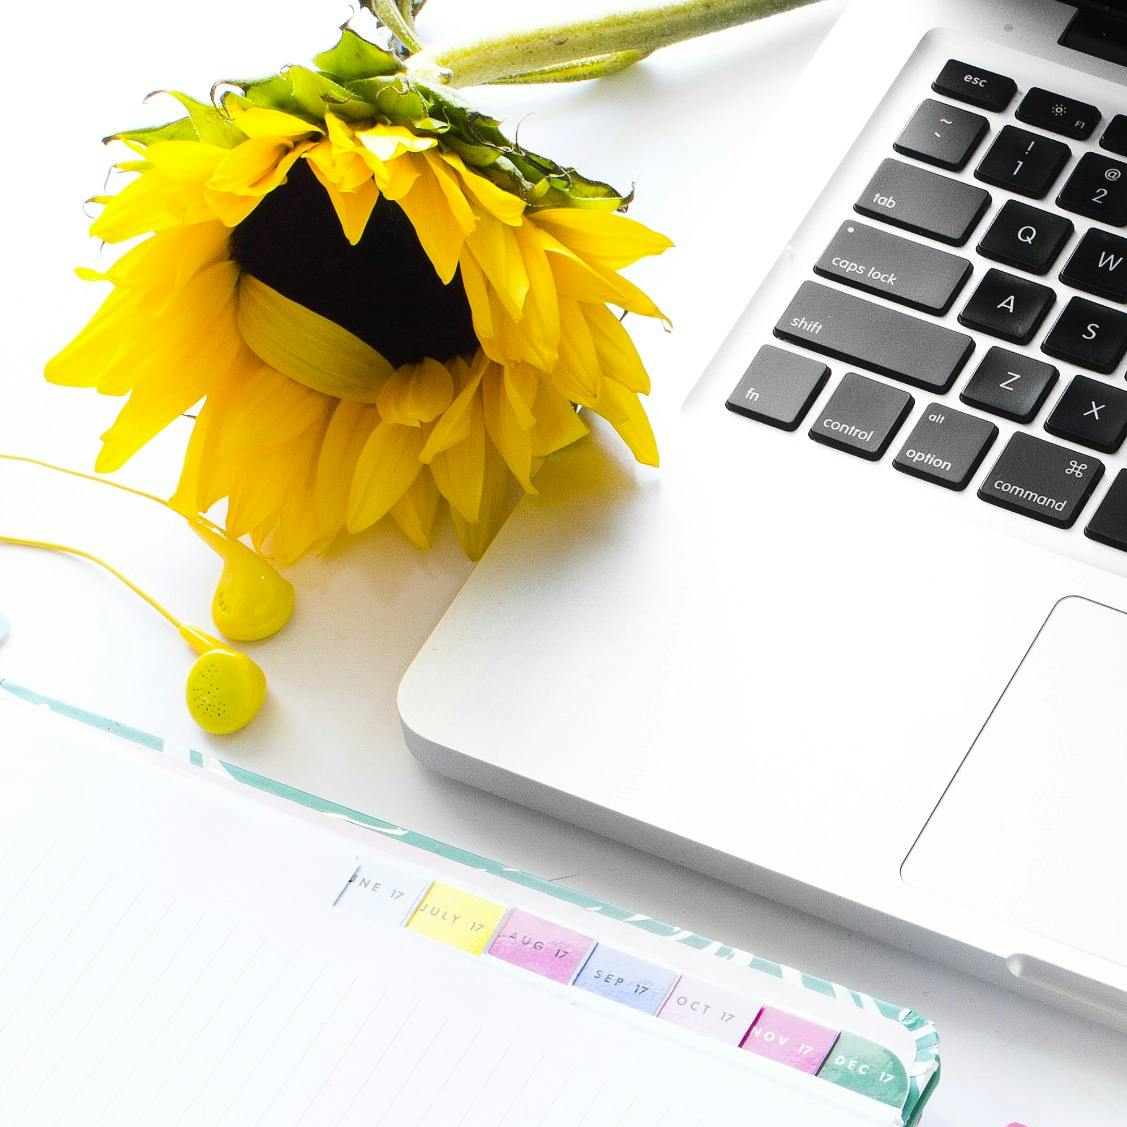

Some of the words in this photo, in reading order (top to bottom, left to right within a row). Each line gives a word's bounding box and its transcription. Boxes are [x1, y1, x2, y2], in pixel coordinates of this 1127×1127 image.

[963, 69, 988, 88] esc
[1074, 120, 1086, 129] F1
[1025, 140, 1036, 155] !
[1012, 160, 1024, 176] 1
[1104, 168, 1122, 182] @
[872, 192, 896, 209] tab
[1091, 188, 1108, 204] 2
[1017, 225, 1037, 245] Q
[831, 256, 866, 275] caps
[867, 266, 898, 286] lock
[1098, 251, 1124, 272] W
[996, 295, 1015, 313] A
[789, 315, 824, 336] shift
[1081, 323, 1100, 340] S
[999, 371, 1022, 391] Z
[745, 387, 760, 402] fn
[928, 413, 945, 425] alt
[1083, 400, 1104, 421] X
[823, 418, 875, 442] control
[905, 445, 952, 473] option
[992, 479, 1069, 513] command
[389, 888, 405, 901] 17
[419, 902, 461, 925] JULY
[469, 920, 484, 933] 17
[508, 930, 544, 952] AUG
[554, 948, 569, 960] 17
[593, 968, 625, 986] SEP
[632, 983, 649, 996] 17
[676, 995, 711, 1016] OCT
[720, 1010, 736, 1024] 17
[751, 1025, 790, 1047] NOV
[799, 1042, 814, 1056] 17
[834, 1054, 870, 1076] DEC
[878, 1070, 894, 1084] 17
